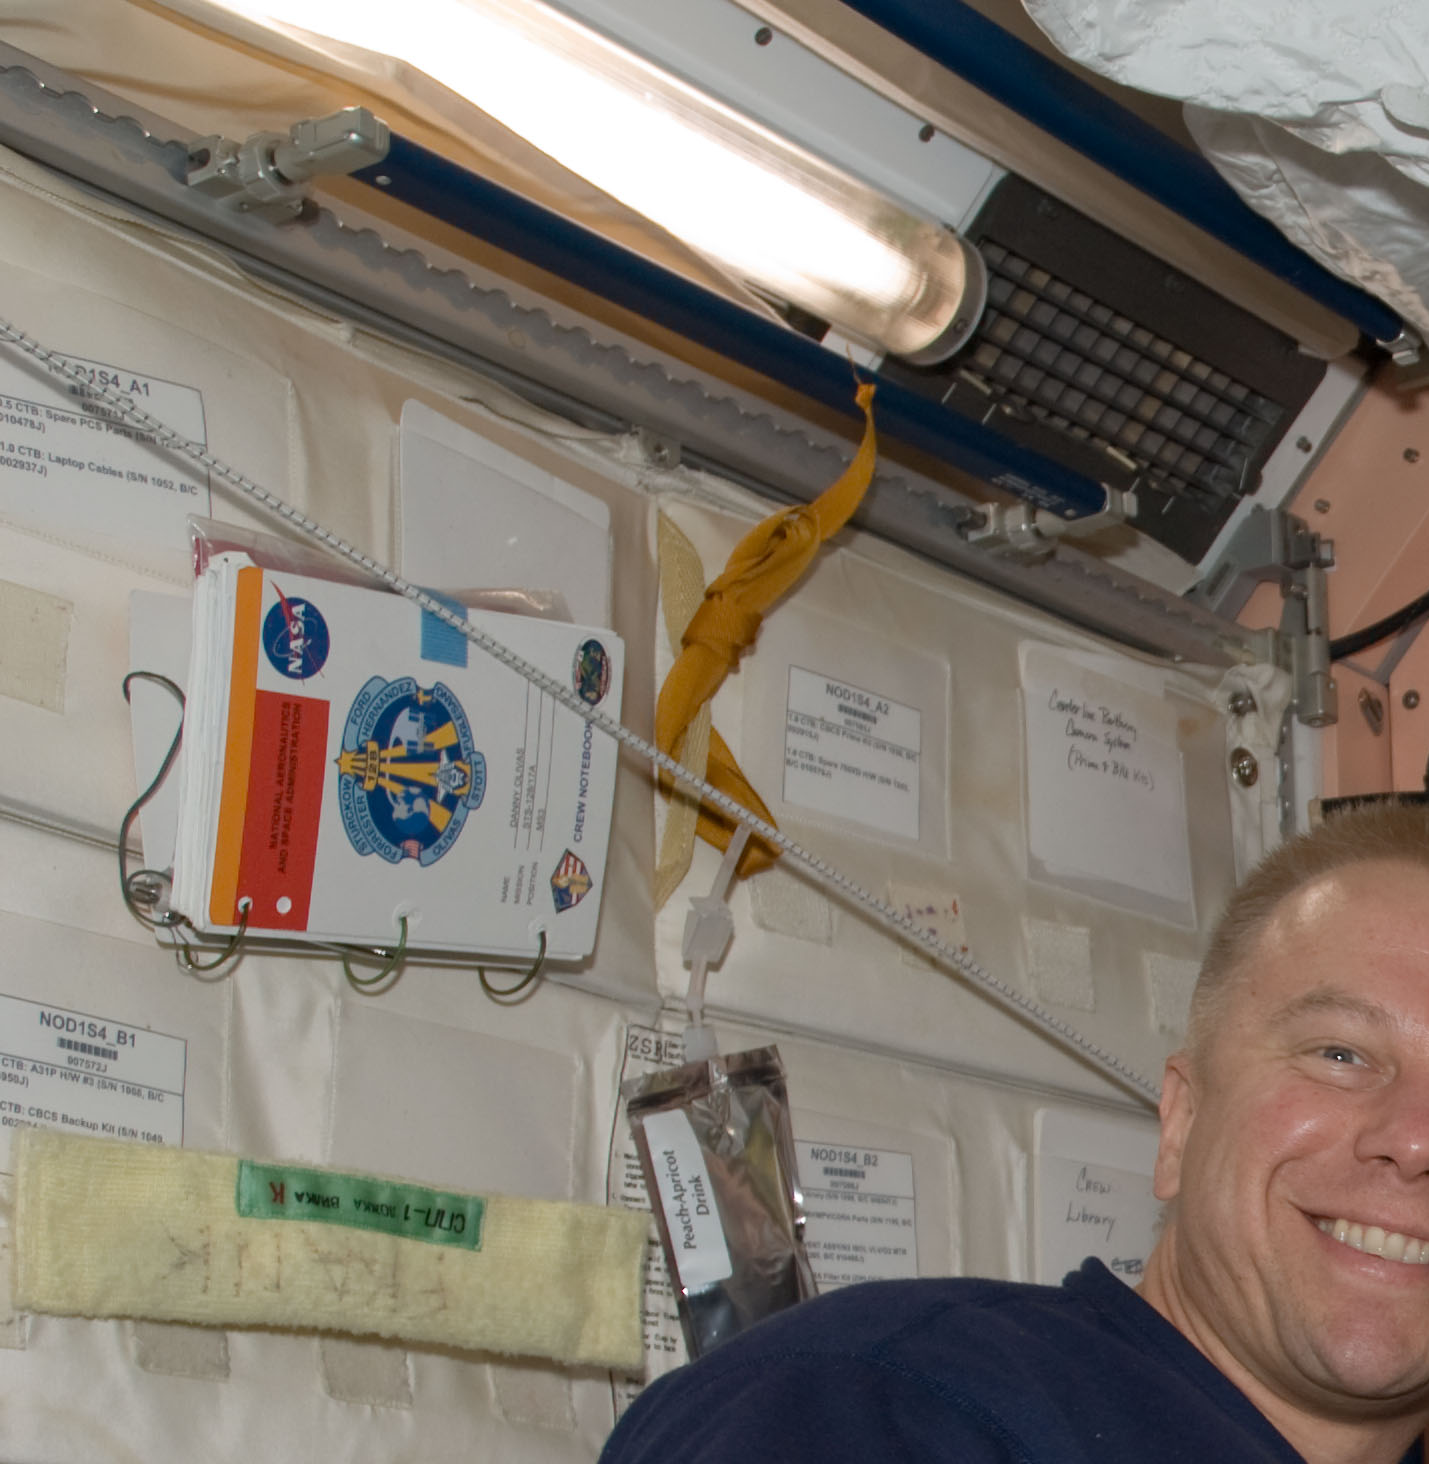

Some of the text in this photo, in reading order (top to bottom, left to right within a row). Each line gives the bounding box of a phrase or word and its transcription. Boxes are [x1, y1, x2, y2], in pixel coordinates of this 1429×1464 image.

[45, 409, 77, 426] Spare
[80, 417, 103, 431] PCS
[48, 452, 85, 471] Laptop
[88, 462, 124, 479] Cables
[287, 603, 307, 676] NASA
[351, 691, 371, 726] FORD
[362, 681, 412, 738] HERNANDEZ
[472, 759, 484, 801] STOTT
[573, 720, 594, 843] CREW NOTEBOOK
[343, 778, 368, 853] STURCKOW
[358, 796, 398, 860] FORRESTER
[433, 818, 461, 857] OLIVAS
[38, 1011, 137, 1048] NOD1S4_B1
[61, 1114, 99, 1132] Backup
[101, 1123, 116, 1136] Kit
[810, 1147, 879, 1168] NOD1S4_B2
[662, 1150, 698, 1250] Peach-Apricot
[687, 1175, 711, 1217] Drink
[402, 1204, 467, 1234] СПП-1
[1065, 1201, 1117, 1243] Library
